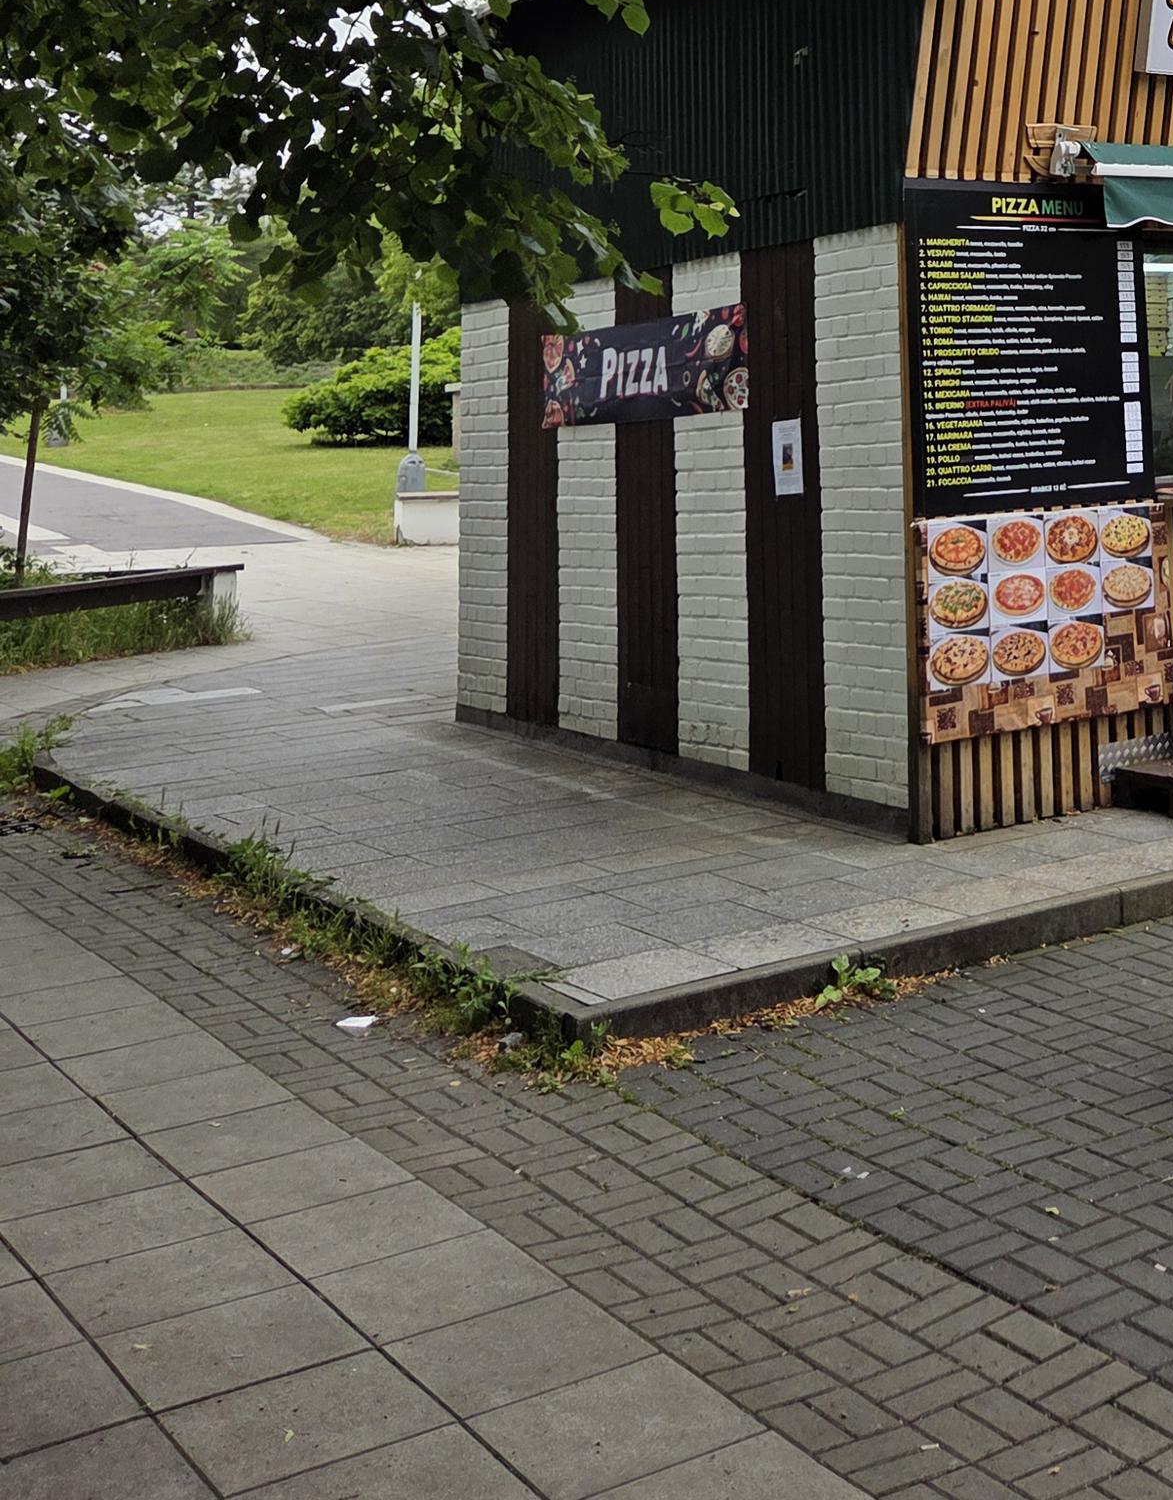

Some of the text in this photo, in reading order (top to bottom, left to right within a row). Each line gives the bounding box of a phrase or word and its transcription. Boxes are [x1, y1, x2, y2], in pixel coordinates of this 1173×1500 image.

[992, 197, 1083, 216] PIZZA MENU
[926, 238, 970, 248] MARGHERITA
[926, 249, 956, 258] VESUVIO
[928, 304, 960, 313] QUATTRO
[928, 315, 961, 323] QUATTRO
[922, 349, 933, 358] 11.
[934, 348, 976, 357] PROSCIUTTO
[600, 346, 668, 398] PIZZA
[937, 455, 960, 463] POLLO
[937, 465, 970, 476] QUATTRO
[926, 479, 937, 488] 21.
